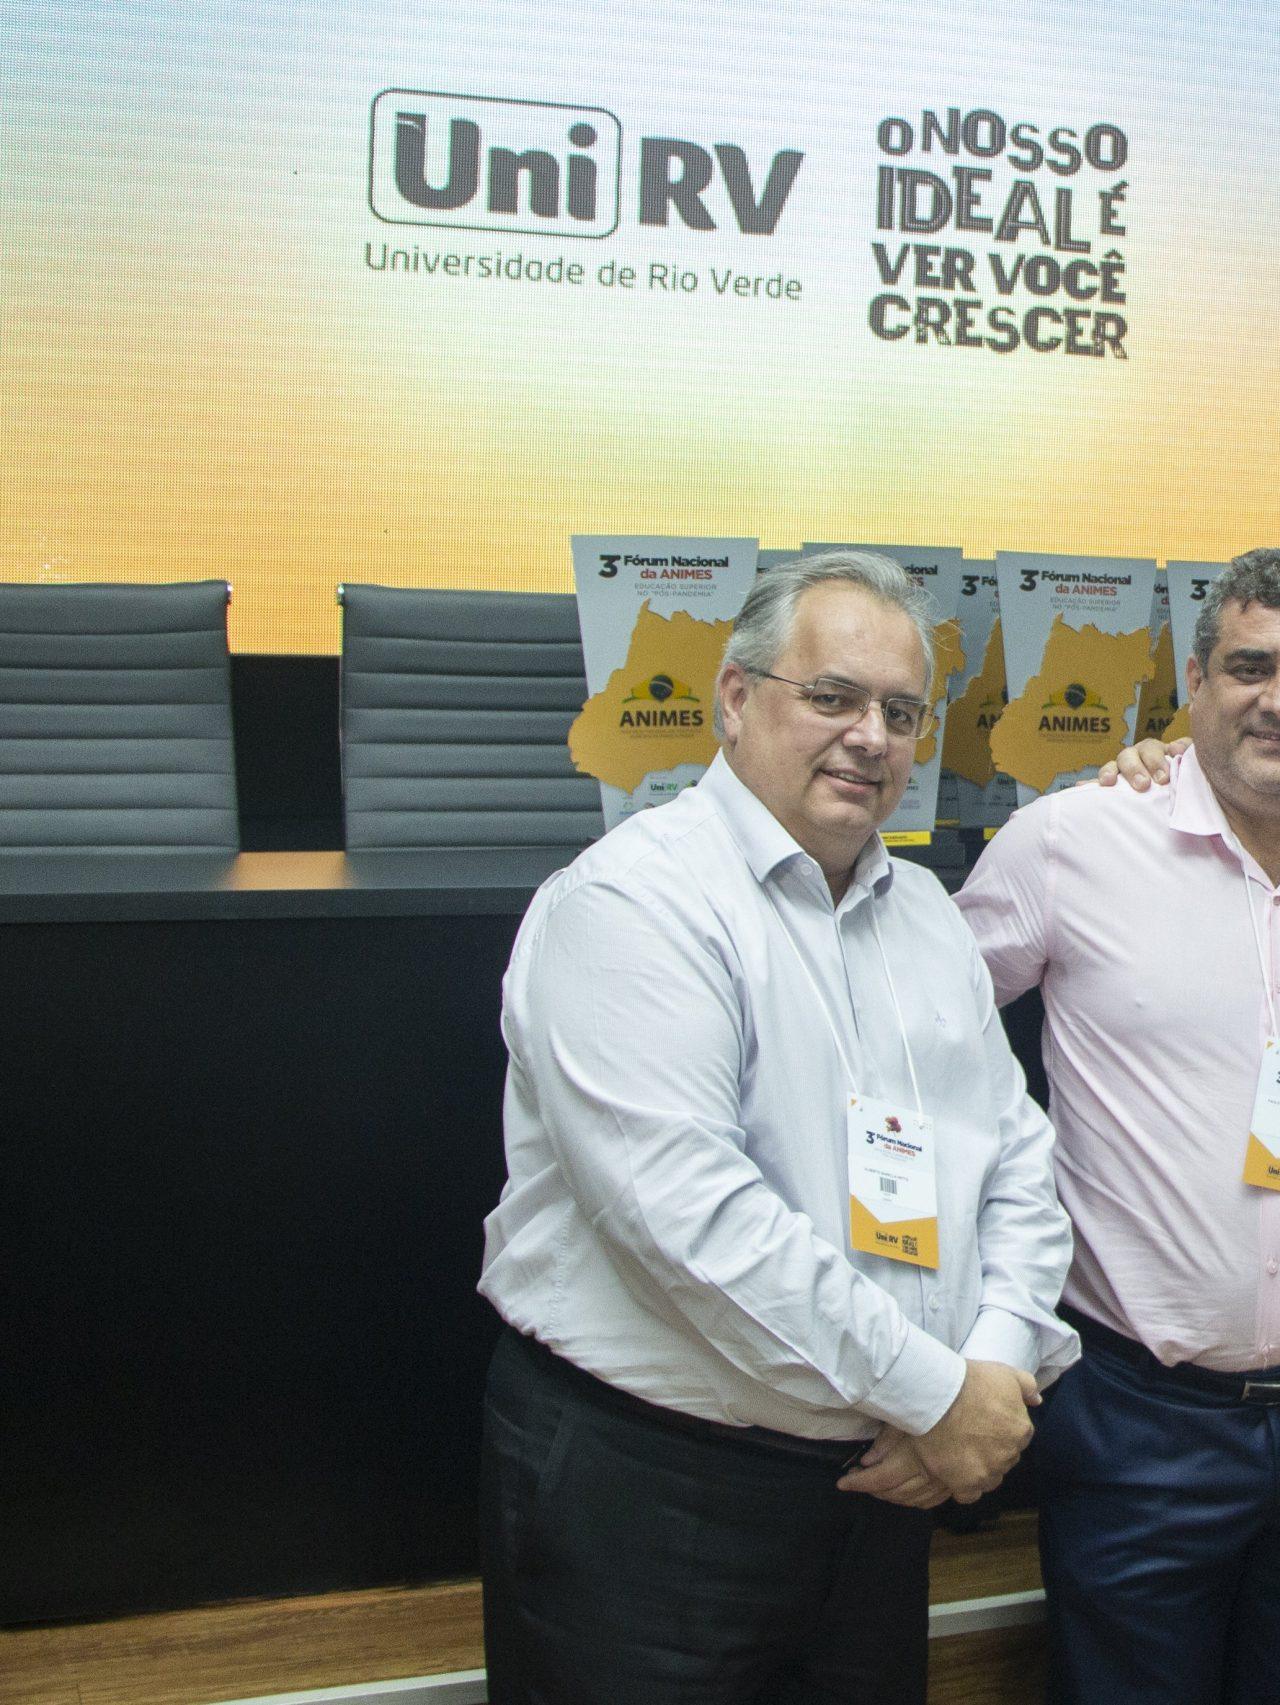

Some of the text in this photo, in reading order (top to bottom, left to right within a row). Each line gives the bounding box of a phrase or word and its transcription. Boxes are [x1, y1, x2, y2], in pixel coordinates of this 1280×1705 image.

[921, 108, 1128, 176] NOSSO
[395, 111, 806, 236] Uni RV
[877, 165, 1129, 253] IDEAL É
[365, 242, 803, 300] Universidade de Rio Verde
[871, 242, 1127, 305] VER VOCÊ
[868, 293, 1128, 360] CRESCER
[624, 554, 668, 566] Fórum
[671, 556, 729, 567] Nacional
[903, 564, 938, 575] cional
[640, 569, 713, 580] da ANIMES
[1041, 571, 1079, 582] Fórum
[1082, 573, 1132, 585] Nacional
[1055, 585, 1118, 596] da ANIMES
[620, 710, 704, 727] ANIMES
[1038, 715, 1111, 733] ANIMES
